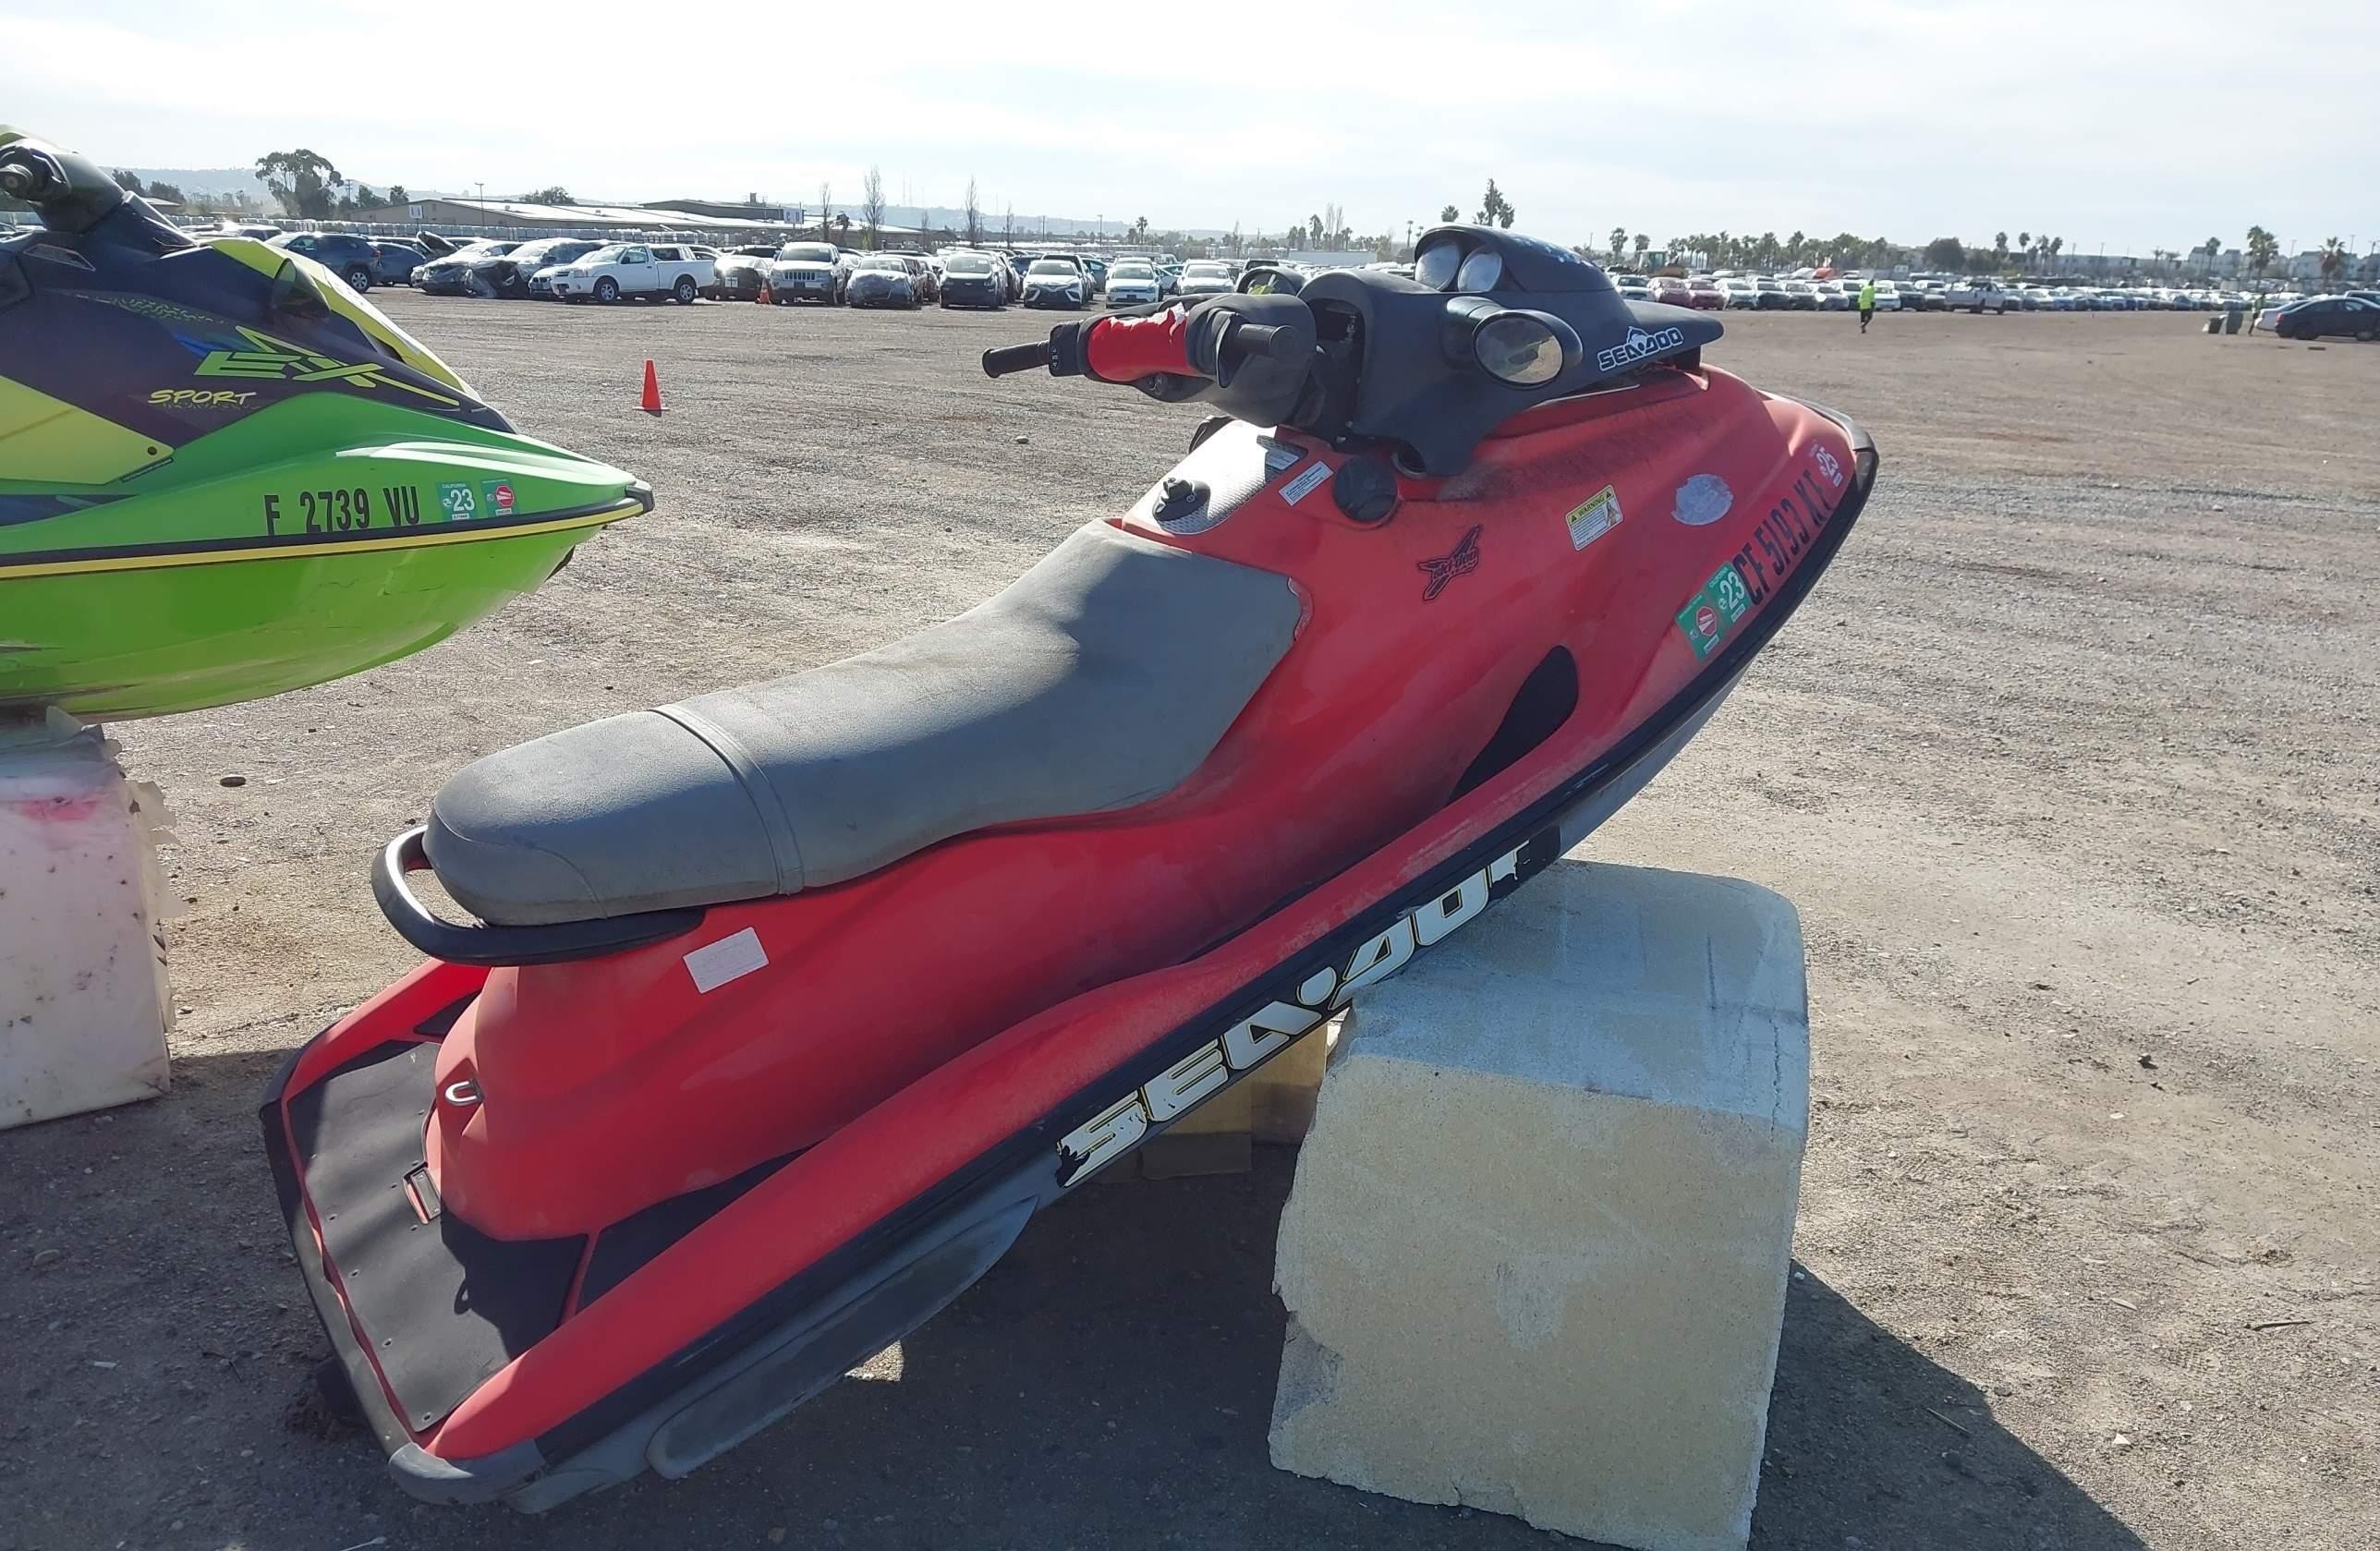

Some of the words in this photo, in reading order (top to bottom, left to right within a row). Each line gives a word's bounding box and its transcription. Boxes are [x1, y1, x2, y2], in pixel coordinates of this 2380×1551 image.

[194, 350, 385, 388] EX
[148, 389, 257, 405] SPORT
[264, 494, 281, 536] F
[299, 487, 370, 533] 2739
[382, 485, 420, 527] VU
[450, 488, 475, 512] 23
[1578, 494, 1605, 516] WARNING
[1719, 571, 1745, 611] 23
[1732, 542, 1770, 605] CF
